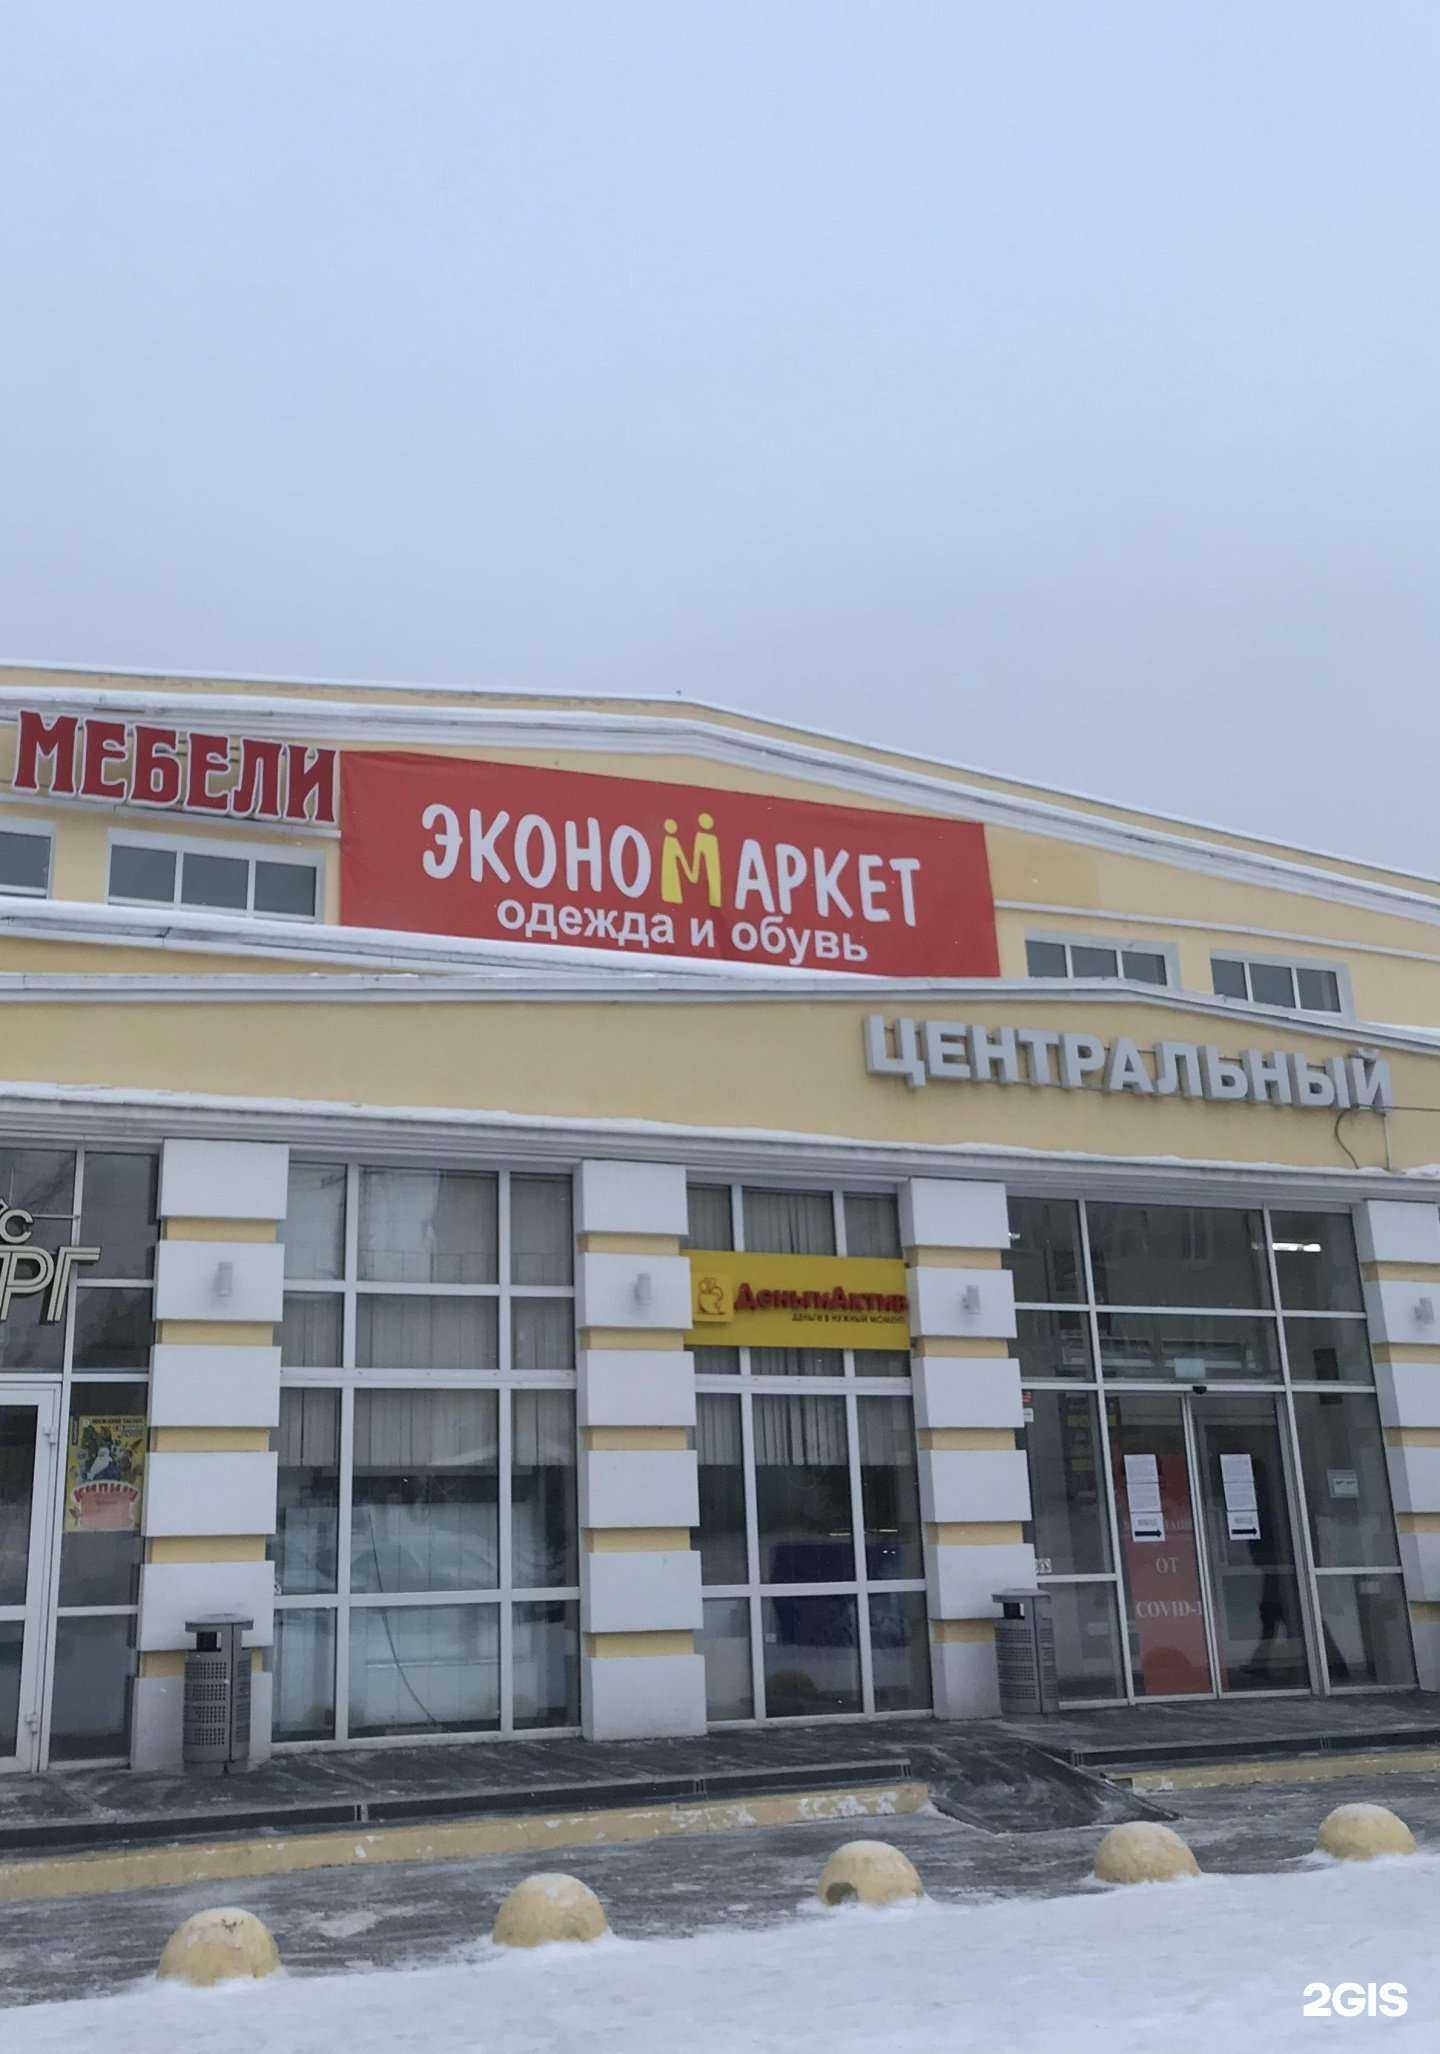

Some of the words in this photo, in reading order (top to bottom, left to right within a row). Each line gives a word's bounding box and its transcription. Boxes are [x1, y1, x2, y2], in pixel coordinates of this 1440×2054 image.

[12, 709, 341, 824] МЕБЕЛИ
[421, 803, 921, 928] ЭКОНОМАРКЕТ
[496, 898, 675, 949] одежда
[690, 919, 715, 948] и
[731, 915, 869, 966] обувь
[863, 1014, 1392, 1111] ЦЕНТРАЛЬНЫЙ
[0, 1245, 102, 1322] РГ
